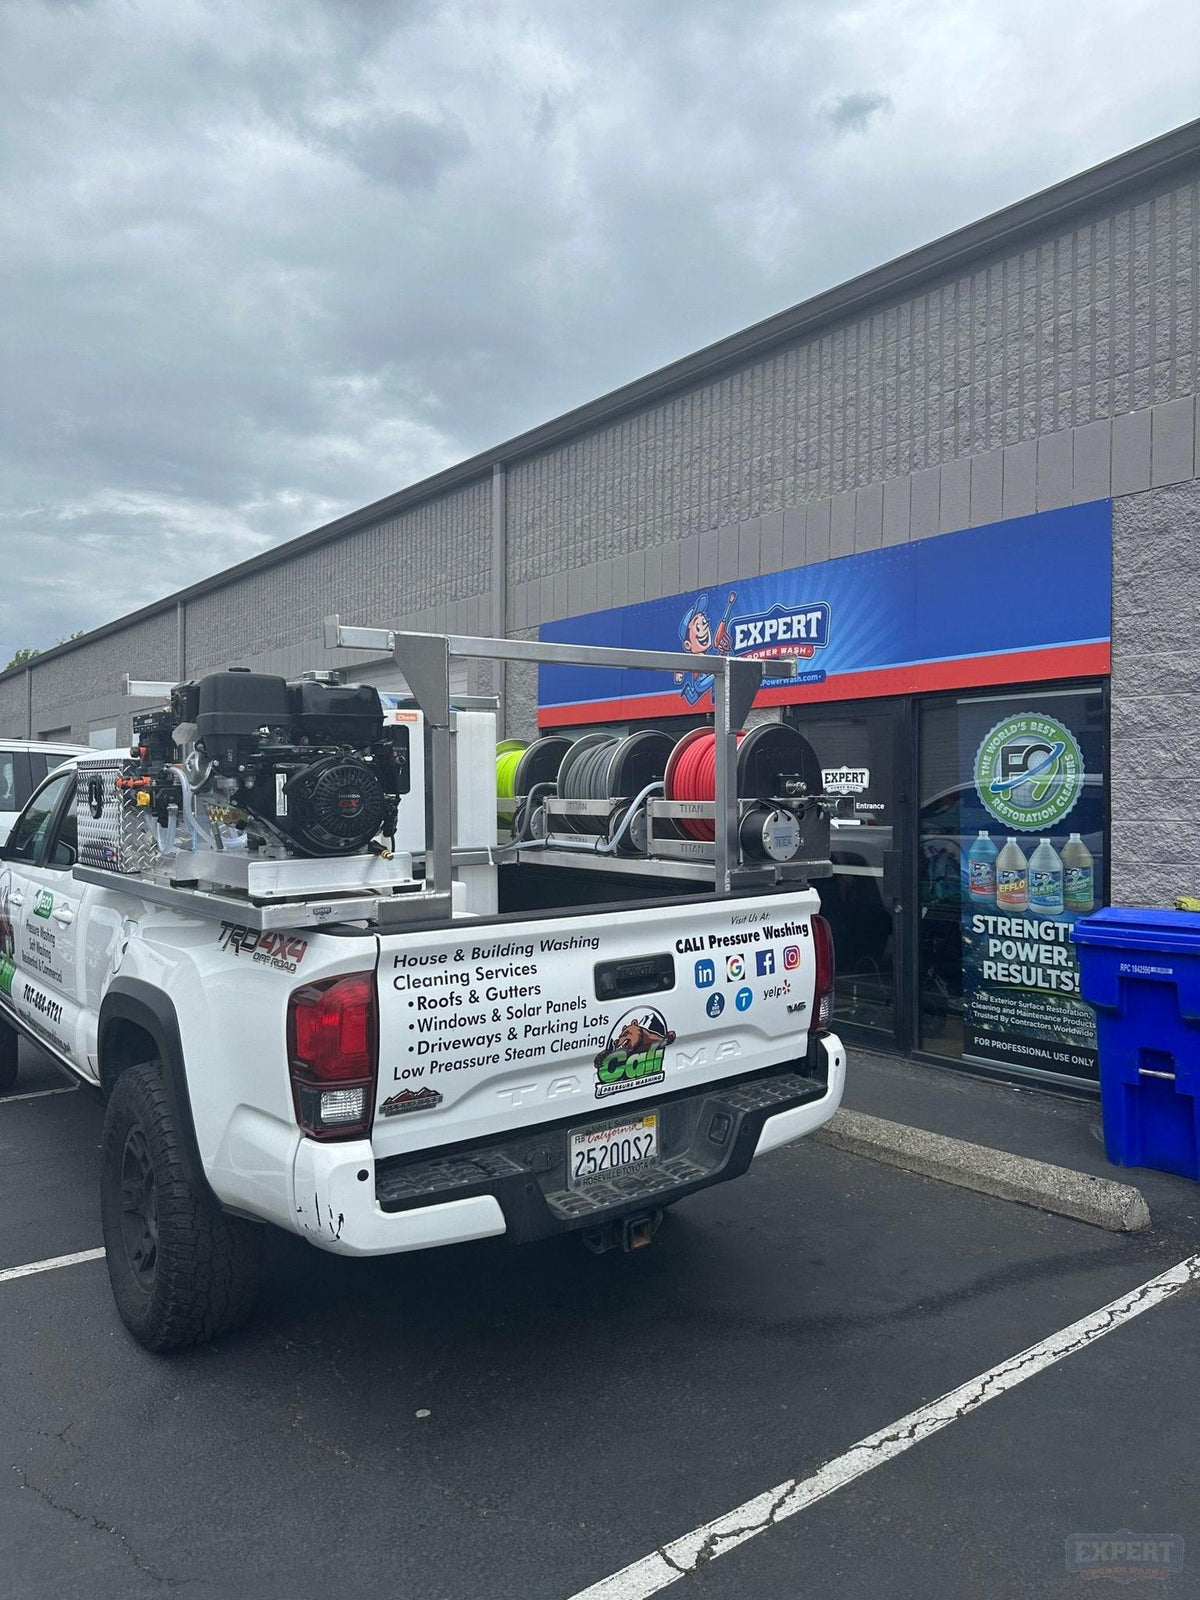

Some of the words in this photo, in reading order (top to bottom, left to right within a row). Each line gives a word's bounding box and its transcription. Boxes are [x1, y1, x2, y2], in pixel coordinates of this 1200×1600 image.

[734, 611, 822, 650] EXPERT
[780, 646, 806, 655] WASH
[981, 756, 992, 776] THE
[987, 721, 1027, 754] WORLD'S
[1030, 721, 1056, 737] BEST
[824, 772, 866, 784] EXPERT
[991, 798, 1058, 823] RESTORATION
[1056, 753, 1076, 807] CLEANERS
[679, 804, 704, 814] TITAN
[855, 802, 885, 810] Entrance
[679, 843, 704, 854] TITAN
[1000, 880, 1025, 893] EFFLO
[731, 915, 747, 925] Visit
[748, 913, 758, 923] Us
[218, 920, 261, 956] TRD
[675, 936, 705, 954] CALI
[708, 930, 760, 949] Pressure
[762, 922, 809, 940] Washing
[253, 952, 271, 964] OFF
[270, 957, 297, 974] ROAD
[393, 954, 448, 969] House
[453, 949, 466, 962] &
[471, 942, 534, 960] Building
[540, 936, 600, 952] Washing
[988, 938, 1074, 967] POWER.
[393, 970, 470, 991] Cleaning
[475, 963, 538, 981] Services
[983, 960, 1080, 992] RESULTS!
[417, 991, 463, 1011] Roofs
[468, 989, 480, 1004] &
[486, 984, 541, 1001] Gutters
[763, 985, 783, 1001] yelp
[976, 993, 989, 1001] The
[990, 994, 1017, 1006] Exterior
[1018, 999, 1045, 1011] Surface
[1046, 1005, 1091, 1018] Restoration,
[417, 1013, 487, 1033] Windows
[491, 1008, 502, 1022] &
[506, 1003, 542, 1020] Solar
[546, 995, 587, 1014] Panels
[971, 1001, 1001, 1013] Cleaning
[1002, 1007, 1014, 1015] and
[1016, 1008, 1061, 1023] Maintenance
[1063, 1016, 1096, 1029] Products
[973, 1010, 999, 1021] Trusted
[1000, 1013, 1010, 1024] By
[1010, 1016, 1051, 1030] Contractors
[1053, 1024, 1094, 1038] Worldwide
[417, 1032, 502, 1055] Driveways
[507, 1026, 518, 1041] &
[523, 1019, 578, 1038] Parking
[583, 1014, 609, 1029] Lots
[393, 1066, 425, 1081] Low
[430, 1054, 500, 1075] Preassure
[504, 1045, 546, 1061] Steam
[550, 1034, 606, 1053] Cleaning
[597, 1044, 665, 1083] Cali
[974, 1036, 990, 1047] FOR
[991, 1039, 1052, 1060] PROFESSIONAL
[1053, 1052, 1070, 1063] USE
[1071, 1055, 1095, 1067] ONLY
[603, 1081, 634, 1094] PRESSURE
[634, 1074, 663, 1088] WASHING
[575, 1133, 653, 1178] 25200S2
[583, 1171, 620, 1186] ROSEVILLE
[623, 1162, 649, 1175] TOYOTA
